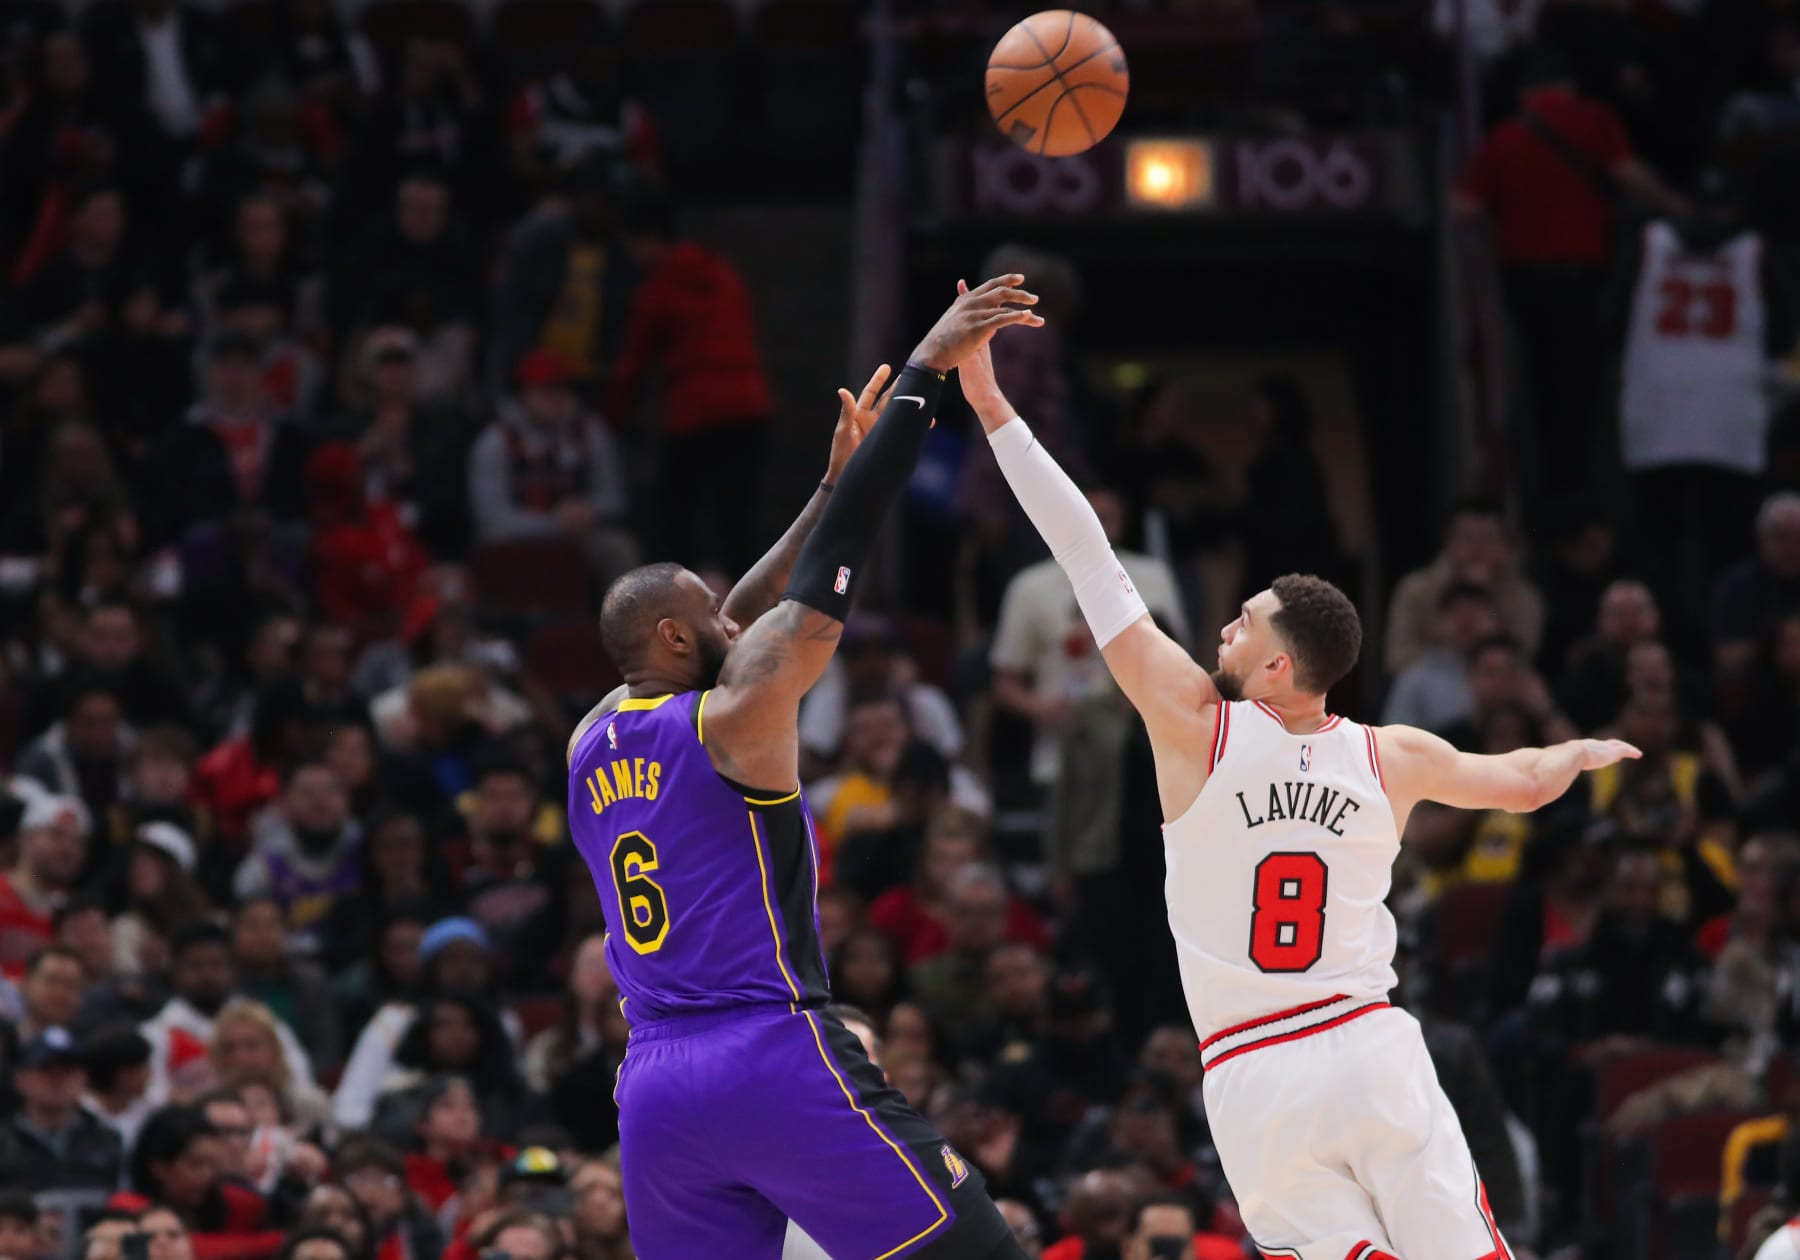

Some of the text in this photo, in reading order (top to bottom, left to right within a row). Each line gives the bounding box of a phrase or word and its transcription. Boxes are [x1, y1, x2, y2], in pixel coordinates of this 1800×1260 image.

[1235, 138, 1372, 210] 106
[1657, 276, 1736, 338] 23
[586, 757, 661, 815] JAMES
[1236, 781, 1361, 837] LAVINE
[609, 830, 670, 955] 6
[1248, 851, 1328, 974] 8
